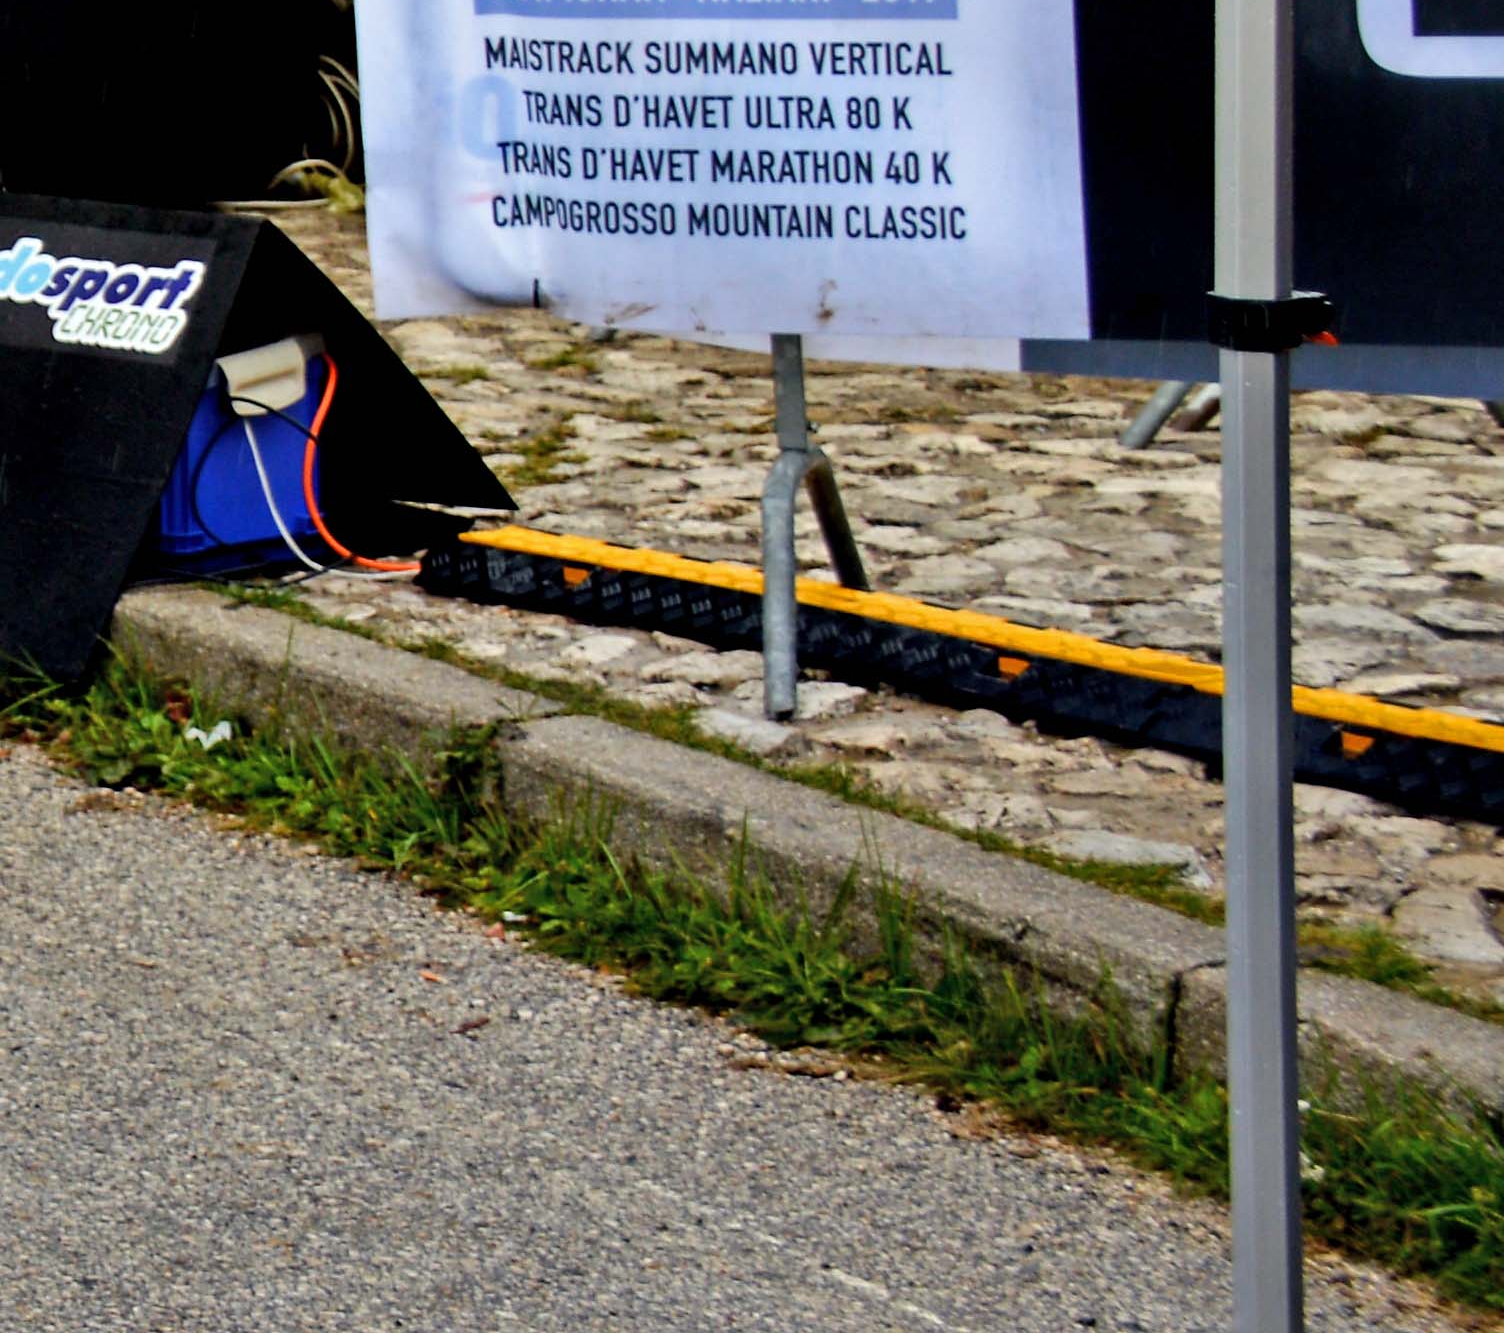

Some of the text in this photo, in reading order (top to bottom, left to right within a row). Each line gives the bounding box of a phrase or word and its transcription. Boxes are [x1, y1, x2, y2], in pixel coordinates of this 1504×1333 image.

[484, 36, 953, 76] MAISTRACK SUMMANO VERTICAL
[522, 90, 913, 130] TRANS D'HAVET ULTRA 80 K
[496, 141, 953, 185] TRANS D'HAVET MARATHON 40 K
[491, 194, 967, 240] CAMPOGROSSO MOUNTAIN CLASSIC
[59, 304, 178, 346] CHRONO
